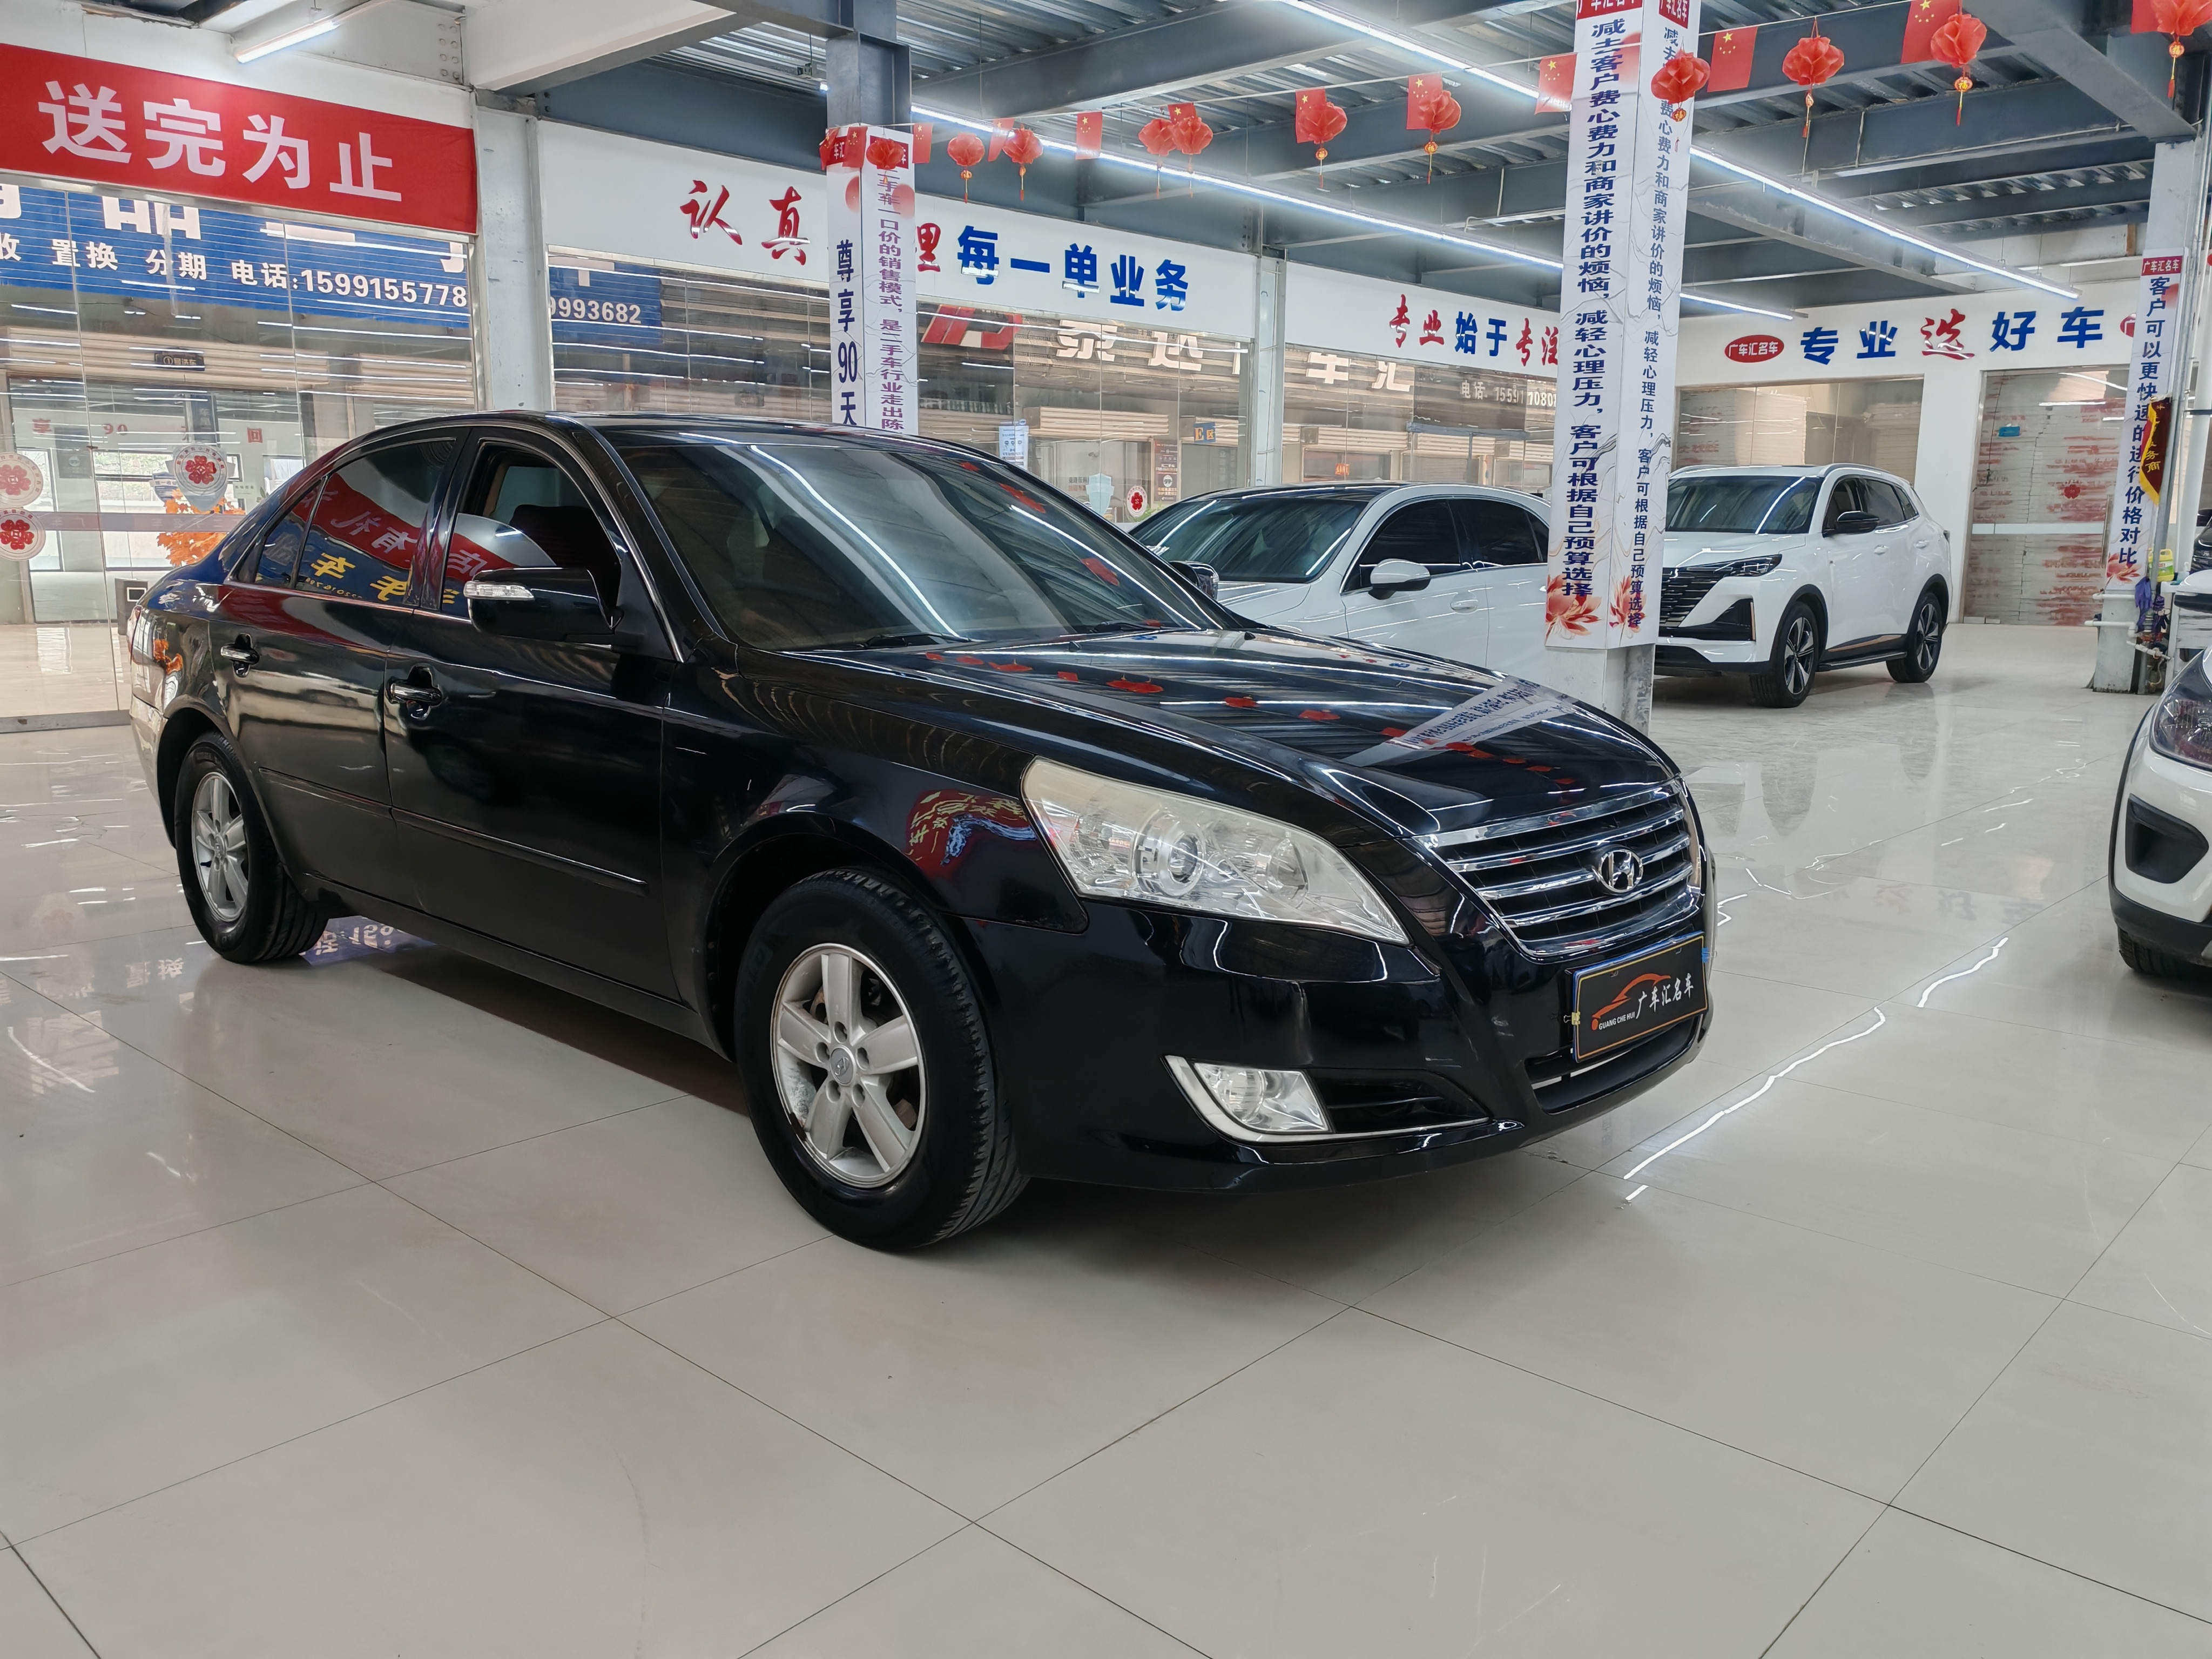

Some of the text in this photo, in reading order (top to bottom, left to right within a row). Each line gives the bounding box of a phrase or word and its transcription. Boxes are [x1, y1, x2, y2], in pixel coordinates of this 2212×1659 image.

[38, 80, 402, 202] 送完为止
[51, 238, 118, 271] 置换
[145, 249, 207, 280] 分期
[2143, 259, 2180, 274] 广车汇名车
[1728, 341, 1779, 358] 广车汇名车
[1800, 306, 2105, 366] 专业选好车
[1636, 973, 1694, 1019] 广车汇名车
[1599, 1011, 1635, 1030] GUANG CHE HUI
